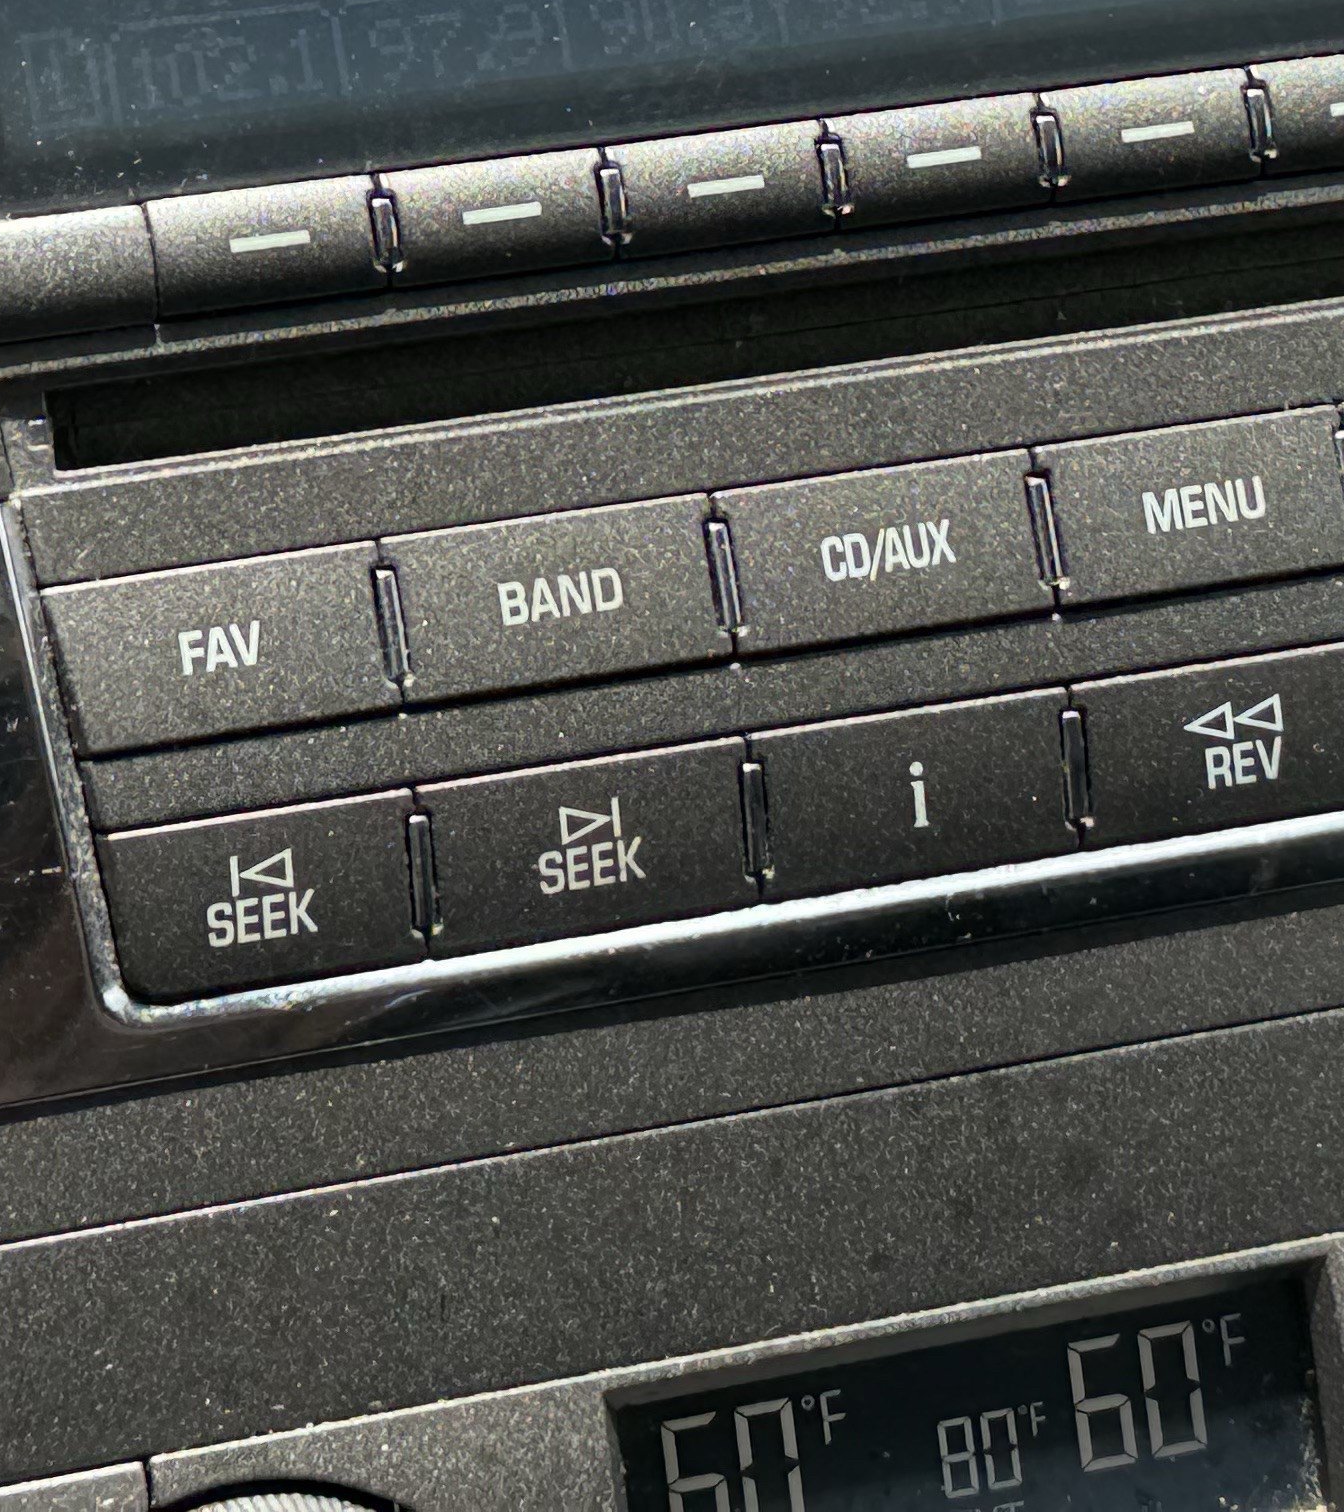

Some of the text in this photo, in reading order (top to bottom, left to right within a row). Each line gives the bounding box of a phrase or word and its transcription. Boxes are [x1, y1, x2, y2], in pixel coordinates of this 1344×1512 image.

[1143, 474, 1266, 535] MENU
[821, 518, 958, 584] CD/AUX
[498, 566, 624, 627] BAND
[178, 619, 261, 676] FAV
[1205, 735, 1283, 790] REV
[538, 835, 646, 896] SEEK
[206, 889, 319, 949] SEEK
[1067, 1312, 1247, 1472] 60°F
